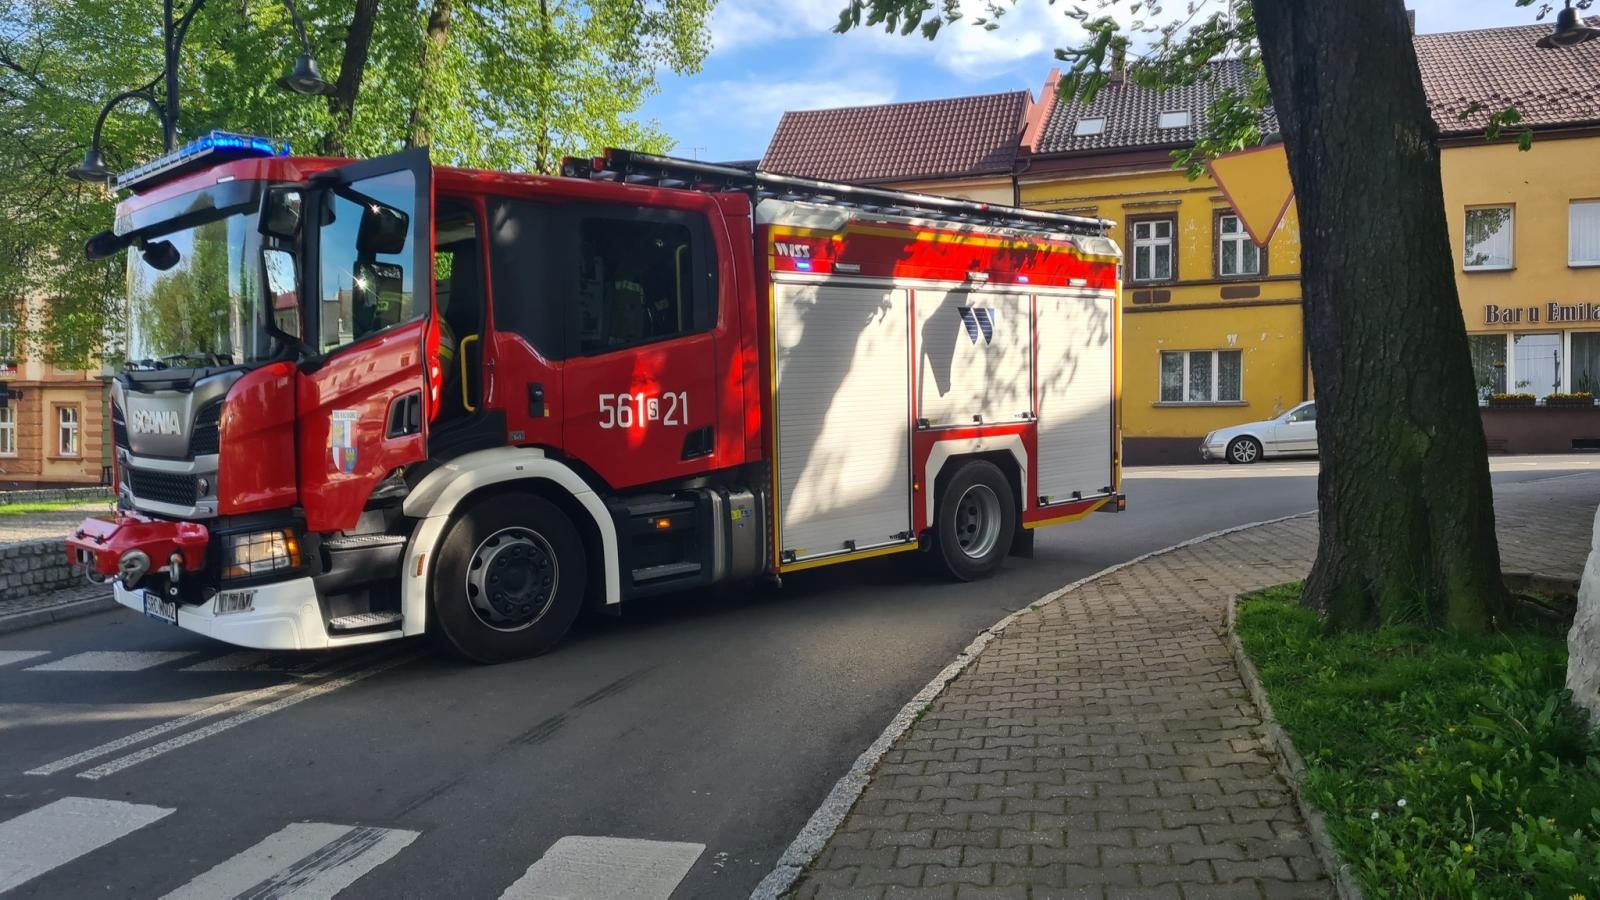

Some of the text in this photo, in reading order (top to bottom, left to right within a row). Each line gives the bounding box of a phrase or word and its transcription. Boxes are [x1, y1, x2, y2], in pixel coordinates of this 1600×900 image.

[775, 242, 811, 258] WISS
[1485, 304, 1523, 324] Bar
[1528, 306, 1540, 323] u
[599, 392, 645, 429] 561
[662, 391, 688, 426] 21
[133, 409, 181, 435] SCANIA
